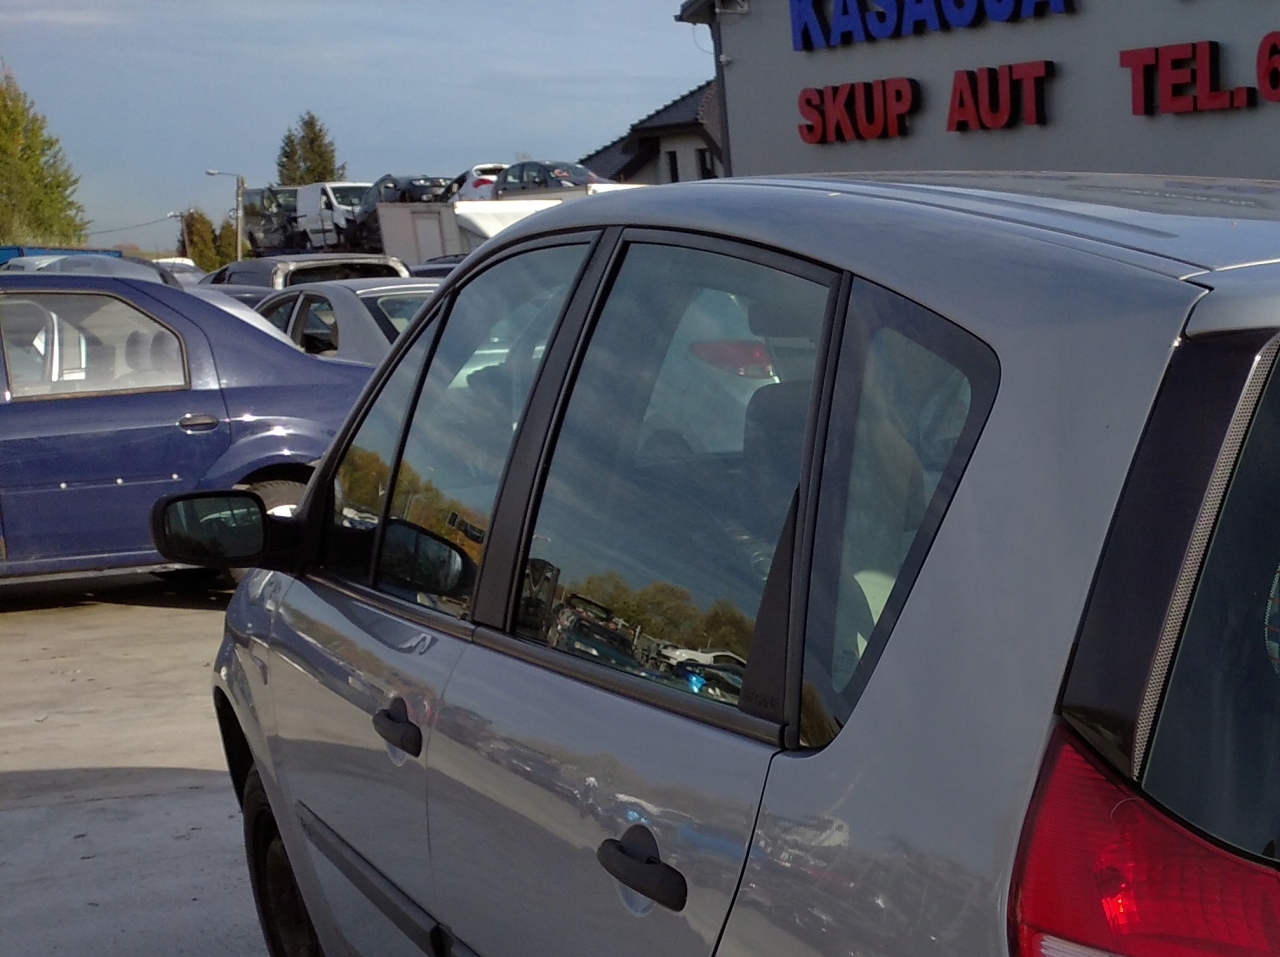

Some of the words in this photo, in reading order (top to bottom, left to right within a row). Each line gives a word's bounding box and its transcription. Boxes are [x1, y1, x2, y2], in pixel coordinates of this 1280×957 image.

[789, 0, 1066, 51] KASA
[797, 77, 915, 145] SKUP
[946, 60, 1049, 132] AUT
